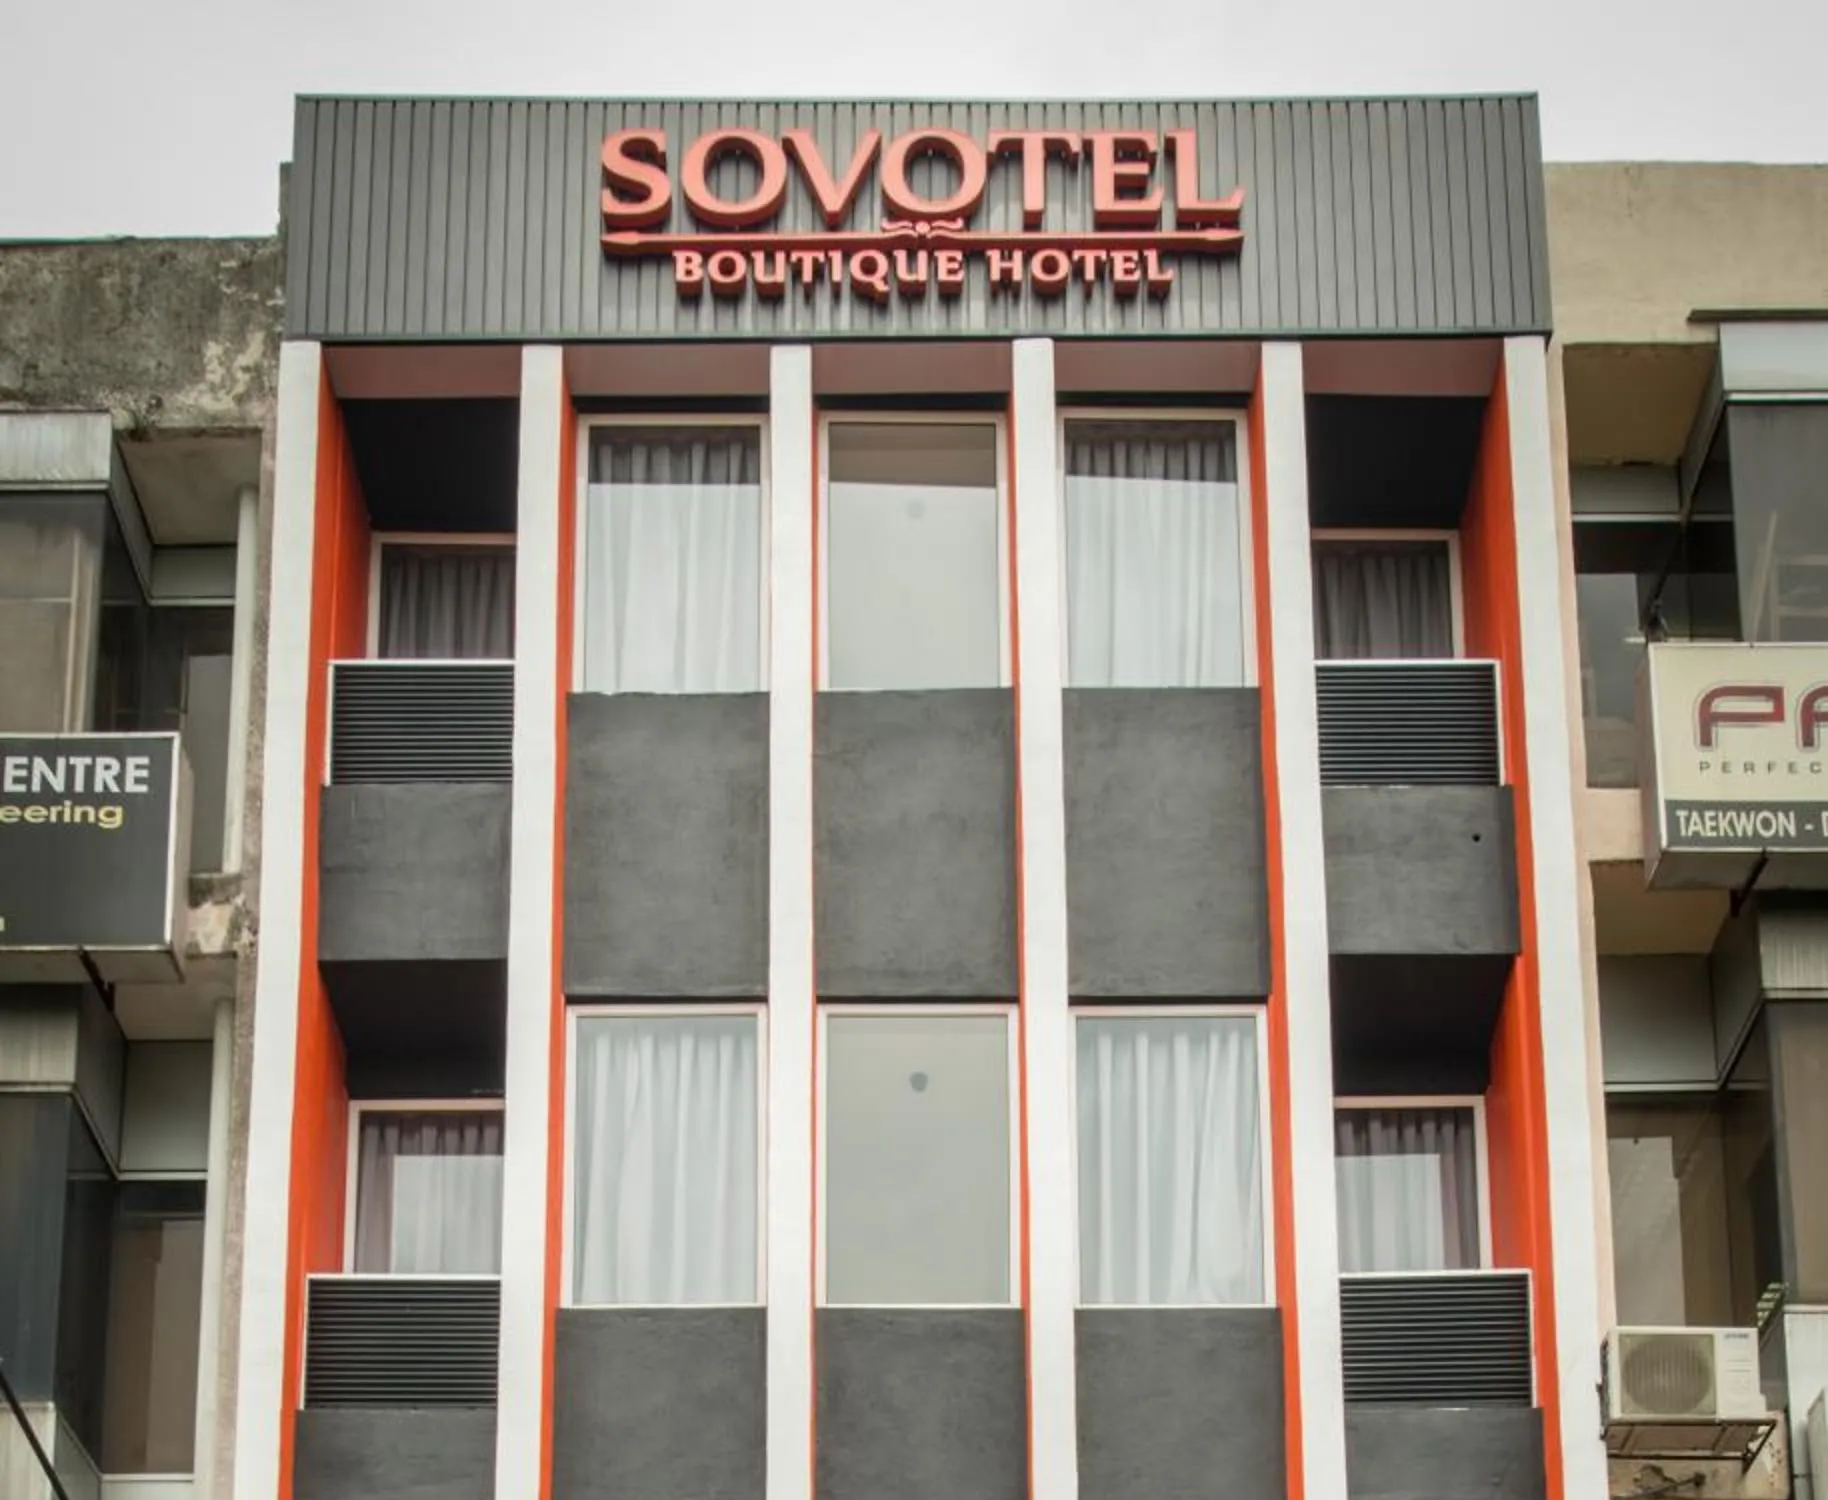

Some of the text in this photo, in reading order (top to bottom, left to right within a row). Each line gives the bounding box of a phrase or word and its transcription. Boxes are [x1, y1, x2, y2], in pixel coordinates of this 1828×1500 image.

[601, 127, 1245, 229] SOVOTEL
[673, 248, 1174, 300] BOUTIQUE HOTEL
[3, 756, 150, 793] ENTRE
[1699, 761, 1823, 775] PERFEC
[0, 801, 124, 829] eering
[1676, 810, 1796, 838] TAEKWON
